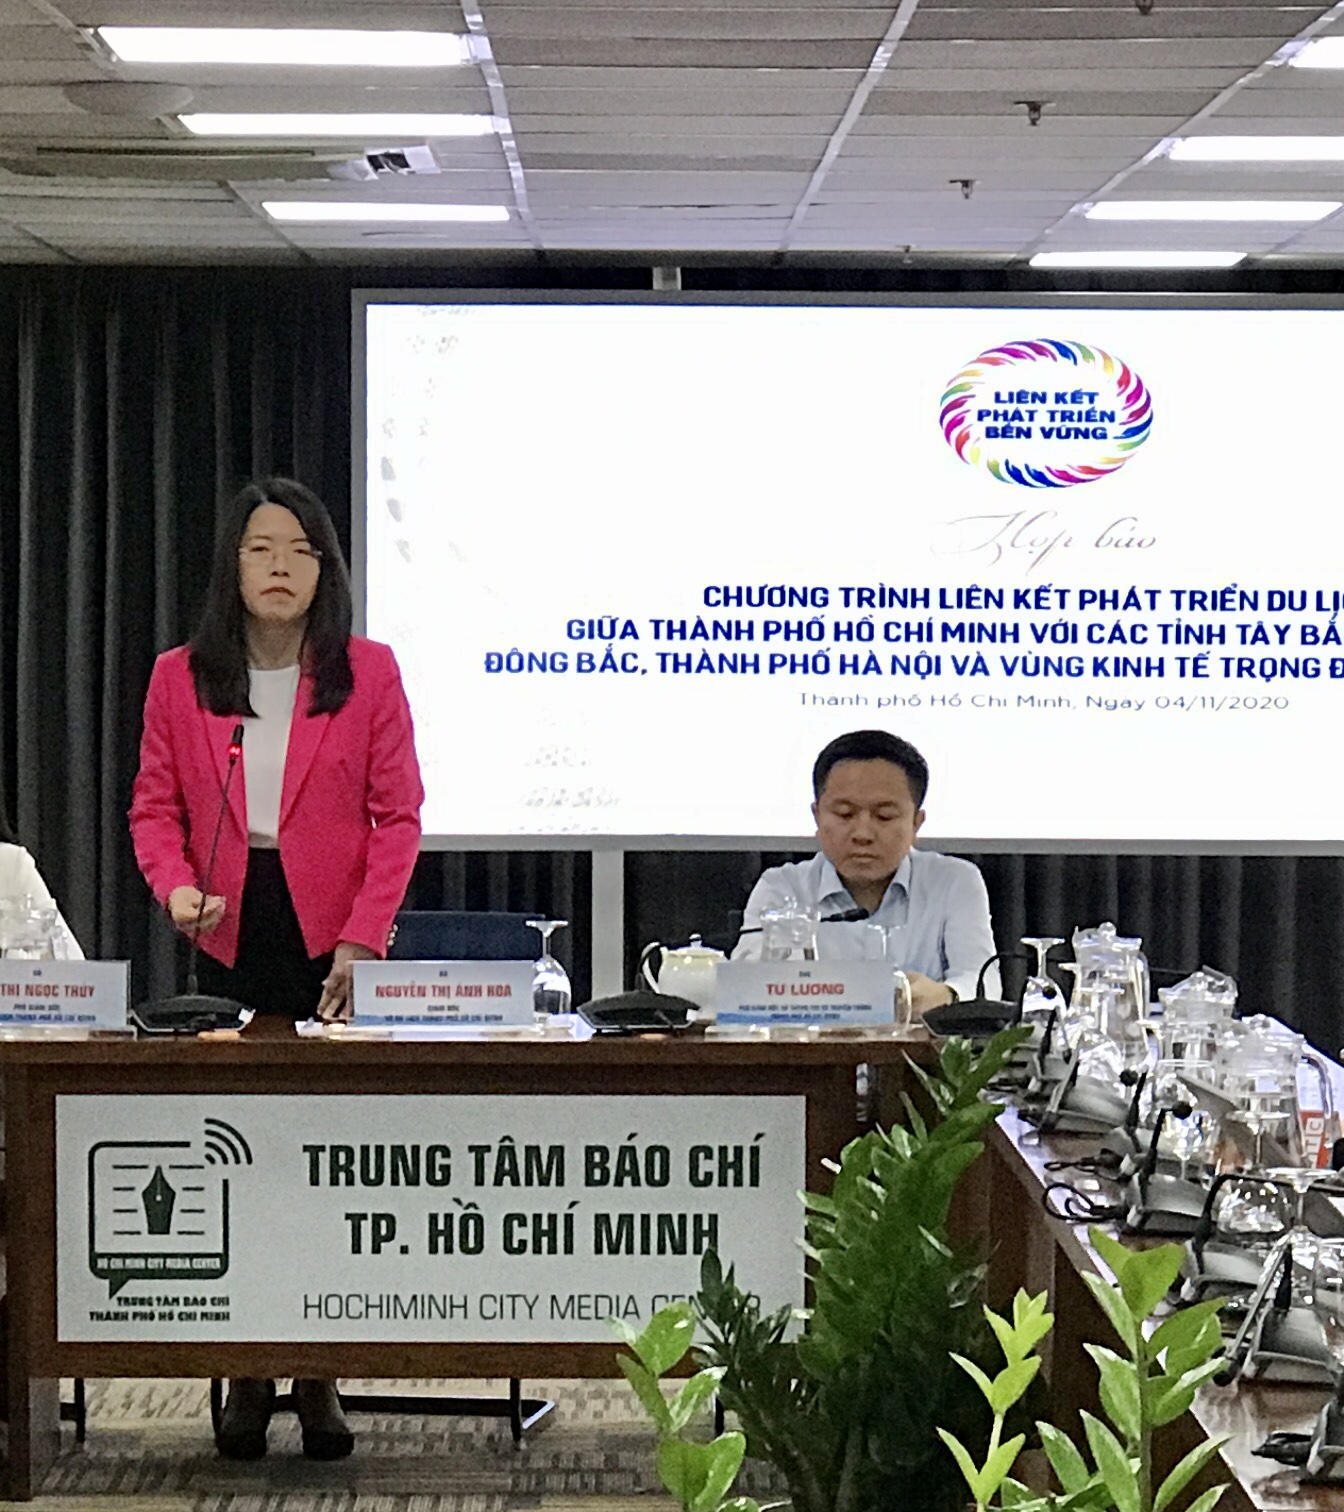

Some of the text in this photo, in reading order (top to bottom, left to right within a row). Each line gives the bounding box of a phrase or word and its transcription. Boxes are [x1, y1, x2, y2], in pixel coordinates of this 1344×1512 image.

[993, 389, 1047, 404] LIÊN
[977, 407, 1038, 422] PHÁT
[703, 584, 830, 609] CHƯƠNG
[839, 583, 931, 609] TRÌNH
[939, 584, 1004, 610] LIÊN
[1014, 583, 1071, 610] KẾT
[1079, 585, 1162, 611] PHÁT
[1170, 583, 1258, 612] TRIỂN
[1267, 590, 1308, 612] DU
[566, 616, 640, 641] GIỮA
[650, 616, 755, 641] THÀNH
[763, 615, 826, 642] PHỐ
[834, 614, 875, 642] HỒ
[884, 616, 934, 643] CHÍ
[941, 622, 1020, 644] MINH
[1030, 619, 1078, 644] VỚI
[1086, 619, 1149, 645] CÁC
[1157, 618, 1226, 646] TỈNH
[1236, 620, 1291, 646] TÂY
[484, 648, 568, 674] ĐÔNG
[576, 643, 648, 676] BẮC,
[655, 648, 760, 675] THÀNH
[768, 647, 832, 675] PHỐ
[839, 649, 883, 676] HÀ
[891, 650, 942, 680] NỘI
[950, 650, 991, 677] VÀ
[1000, 650, 1085, 678] VÙNG
[1092, 656, 1165, 678] KINH
[1175, 650, 1211, 679] TẾ
[1220, 656, 1321, 682] TRỌNG
[1155, 695, 1290, 712] 04/11/2020
[303, 1132, 766, 1188] TRUNG TÂM BÁO CHÍ
[345, 1197, 719, 1255] TP. HỒ CHÍ MINH
[303, 1294, 469, 1320] HOCHIMINH
[479, 1294, 539, 1320] CITY
[550, 1294, 640, 1320] MEDIA
